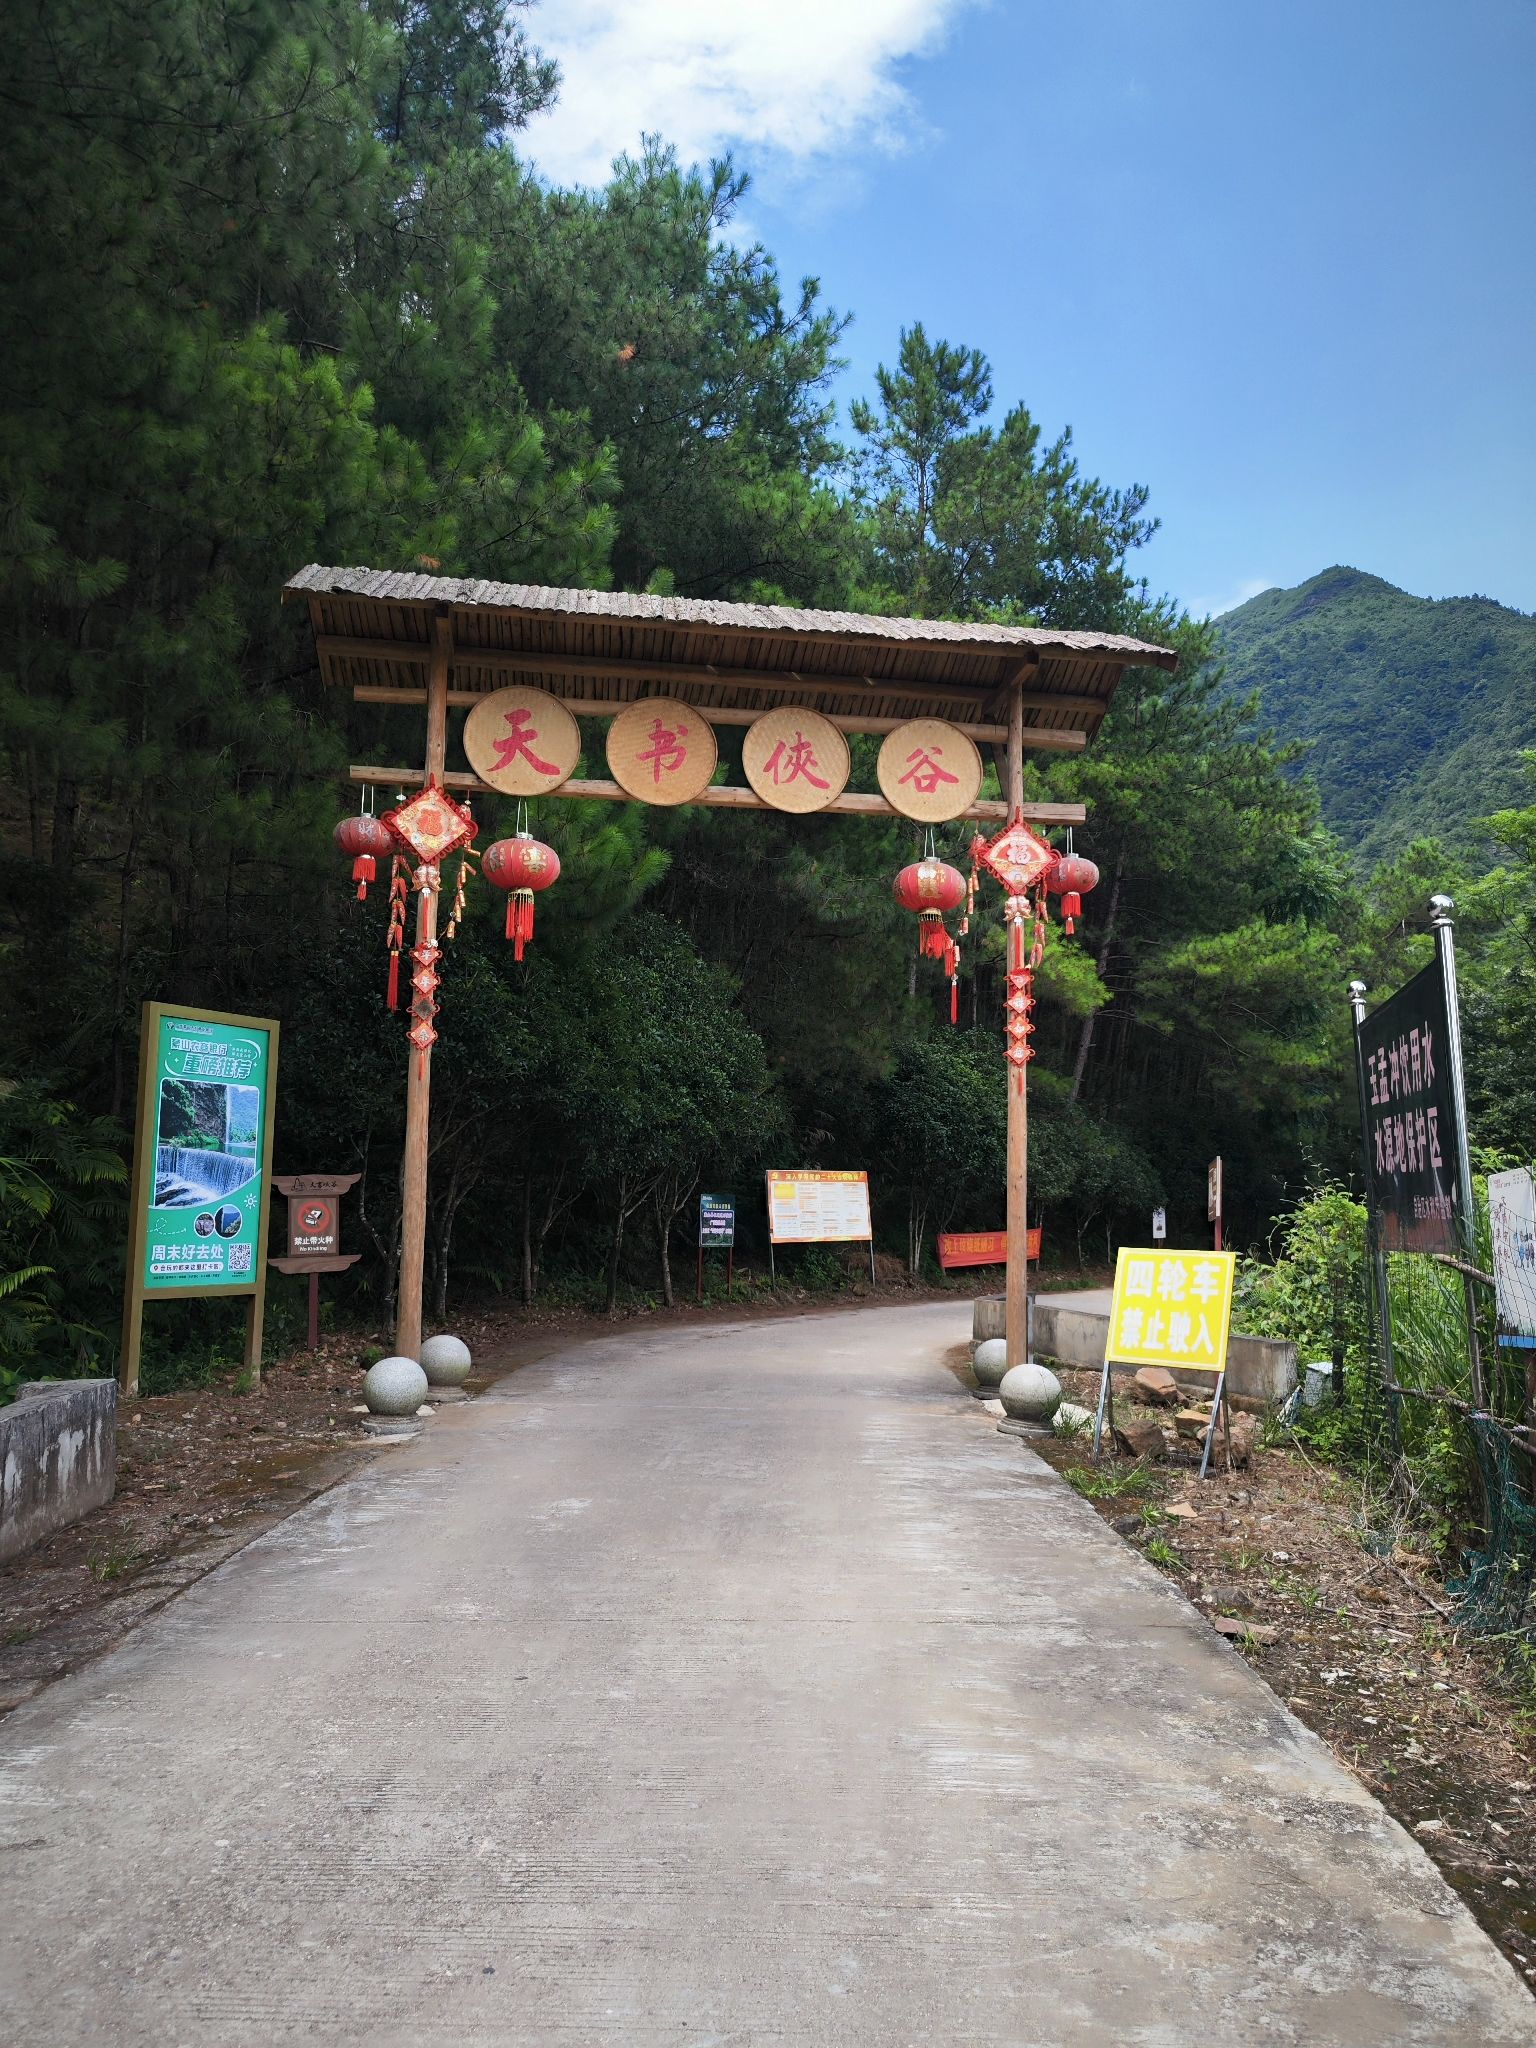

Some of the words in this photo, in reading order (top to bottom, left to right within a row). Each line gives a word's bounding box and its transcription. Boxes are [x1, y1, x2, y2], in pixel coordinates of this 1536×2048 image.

[182, 1052, 253, 1079] 重磅推荐
[1374, 1106, 1443, 1176] 水源地保护区
[151, 1243, 225, 1261] 周末好去处
[1126, 1259, 1220, 1304] 四轮车
[1120, 1307, 1214, 1354] 禁止驶入
